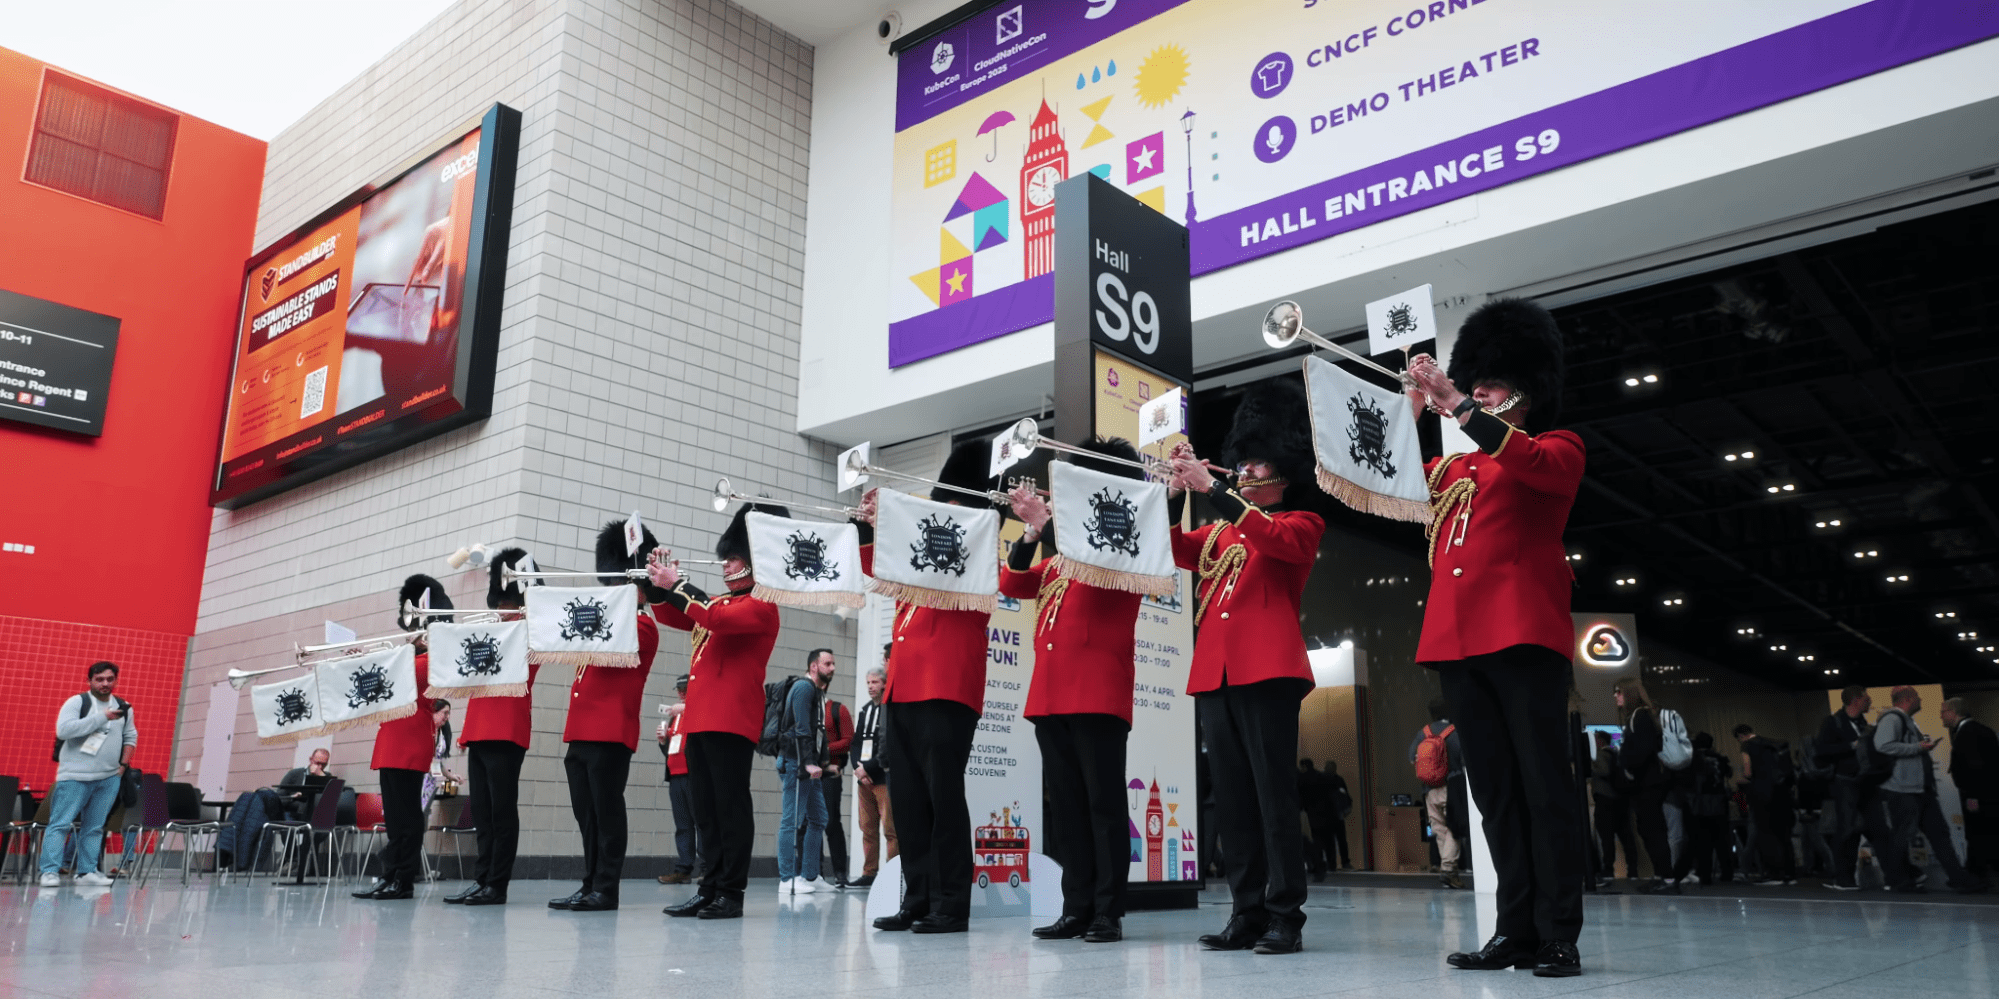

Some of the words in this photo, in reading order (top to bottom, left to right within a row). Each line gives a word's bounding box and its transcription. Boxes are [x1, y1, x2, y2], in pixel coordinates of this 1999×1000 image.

[974, 32, 1047, 72] CloudNativeCon
[1306, 26, 1377, 68] CNCF
[923, 73, 960, 96] KubeCon
[959, 74, 987, 93] Europe
[987, 63, 1008, 80] 2025
[1310, 92, 1390, 135] DEMO
[1398, 37, 1540, 102] THEATER
[441, 141, 480, 183] excel
[1241, 206, 1317, 247] HALL
[1324, 144, 1505, 221] ENTRANCE
[1514, 129, 1561, 161] S9
[278, 235, 337, 281] STANDBUILDER
[1095, 238, 1129, 274] Hall
[252, 292, 305, 333] SUSTAINABLE
[303, 274, 338, 308] STANDS
[267, 316, 294, 339] MADE
[292, 302, 315, 327] EASY
[1095, 272, 1160, 355] S9
[0, 361, 46, 377] ntrance
[0, 374, 26, 388] ince
[28, 380, 73, 397] Regent
[0, 389, 15, 400] ks
[1153, 614, 1168, 625] 19:45
[986, 626, 1020, 646] AVE
[1136, 639, 1157, 651] SDAY,
[1158, 644, 1162, 652] 3
[1163, 645, 1180, 655] APRIL
[987, 648, 1018, 666] FUN!
[1133, 654, 1148, 664] 0:30
[1154, 657, 1170, 668] 17:00
[986, 679, 1001, 688] AZY
[1002, 681, 1021, 691] GOLF
[1135, 683, 1151, 694] DAY,
[1158, 687, 1175, 697] APRIL
[1133, 697, 1148, 707] 0:30
[1153, 700, 1170, 710] 14:00
[983, 711, 1004, 722] IENDS
[1006, 714, 1015, 722] AT
[976, 723, 990, 731] ADE
[991, 724, 1011, 733] ZONE
[977, 744, 1007, 754] CUSTOM
[968, 755, 982, 764] TTE
[984, 756, 1017, 767] CREATED
[968, 767, 1006, 777] SOUVENIR
